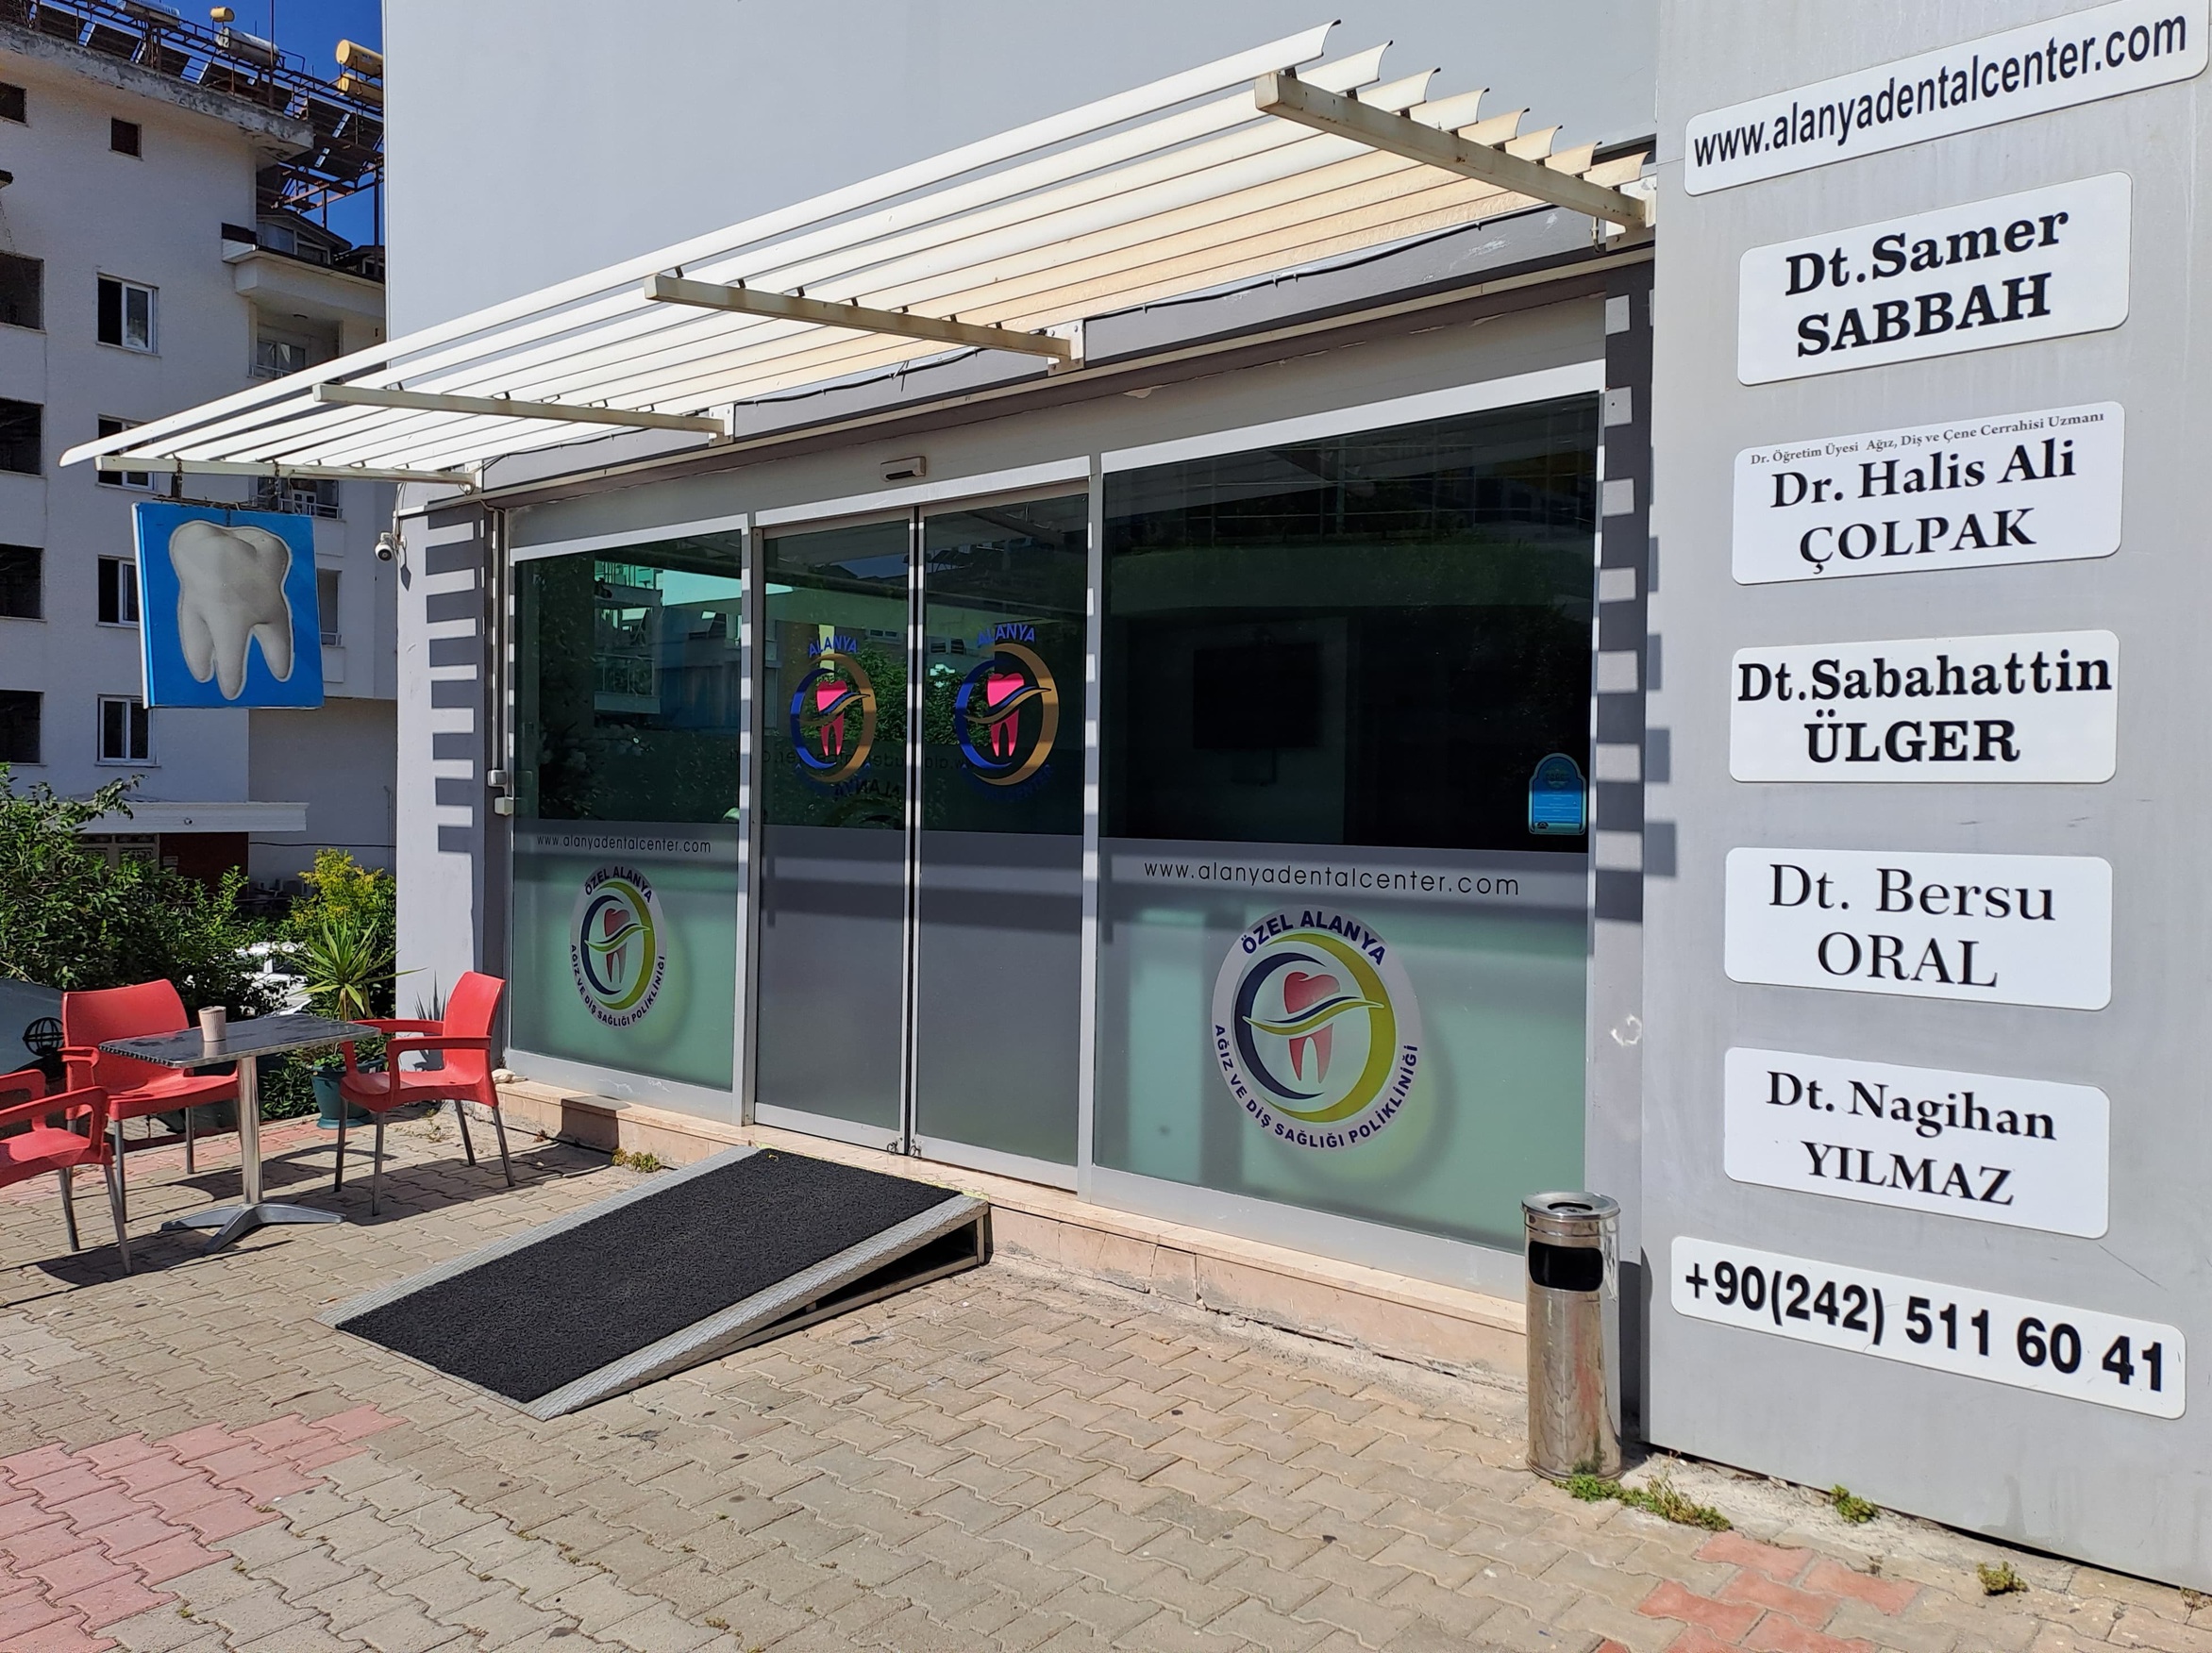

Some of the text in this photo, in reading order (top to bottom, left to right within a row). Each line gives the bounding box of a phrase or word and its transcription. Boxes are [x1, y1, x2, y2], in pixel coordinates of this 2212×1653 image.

[1694, 15, 2187, 168] www.alanyadentalcenter.com
[1785, 210, 2070, 296] Dt.Samer
[1797, 272, 2053, 358] SABBAH
[1751, 413, 2104, 465] Dr. Öğretim Üyesi Ağız, Diş ve Çene Cerrahisi Uzmanı
[1769, 437, 2077, 509] Dr. Halis Ali
[1799, 507, 2036, 575] ÇOLPAK
[809, 635, 857, 658] ALANYA
[977, 623, 1035, 648] ALANYA
[1737, 649, 2112, 702] Dt.Sabahattin
[1804, 709, 2020, 763] ÜLGER
[537, 834, 711, 854] www.alanyadentalcenter.com
[584, 866, 652, 903] ÖZEL ALANYA
[1144, 860, 1519, 896] www.alanyadentalcenter.com
[1768, 863, 2056, 922] Dt. Bersu
[1241, 910, 1385, 965] ÖZEL ALANYA
[1817, 931, 1998, 989] ORAL
[1215, 1025, 1418, 1148] AĞIZ VE DİŞ SAĞLIĞI POLİKLİNİĞİ
[1766, 1071, 2057, 1141] Dt. Nagihan
[1800, 1140, 2016, 1207] YILMAZ
[1685, 1260, 2163, 1392] +90(242) 511 60 41
